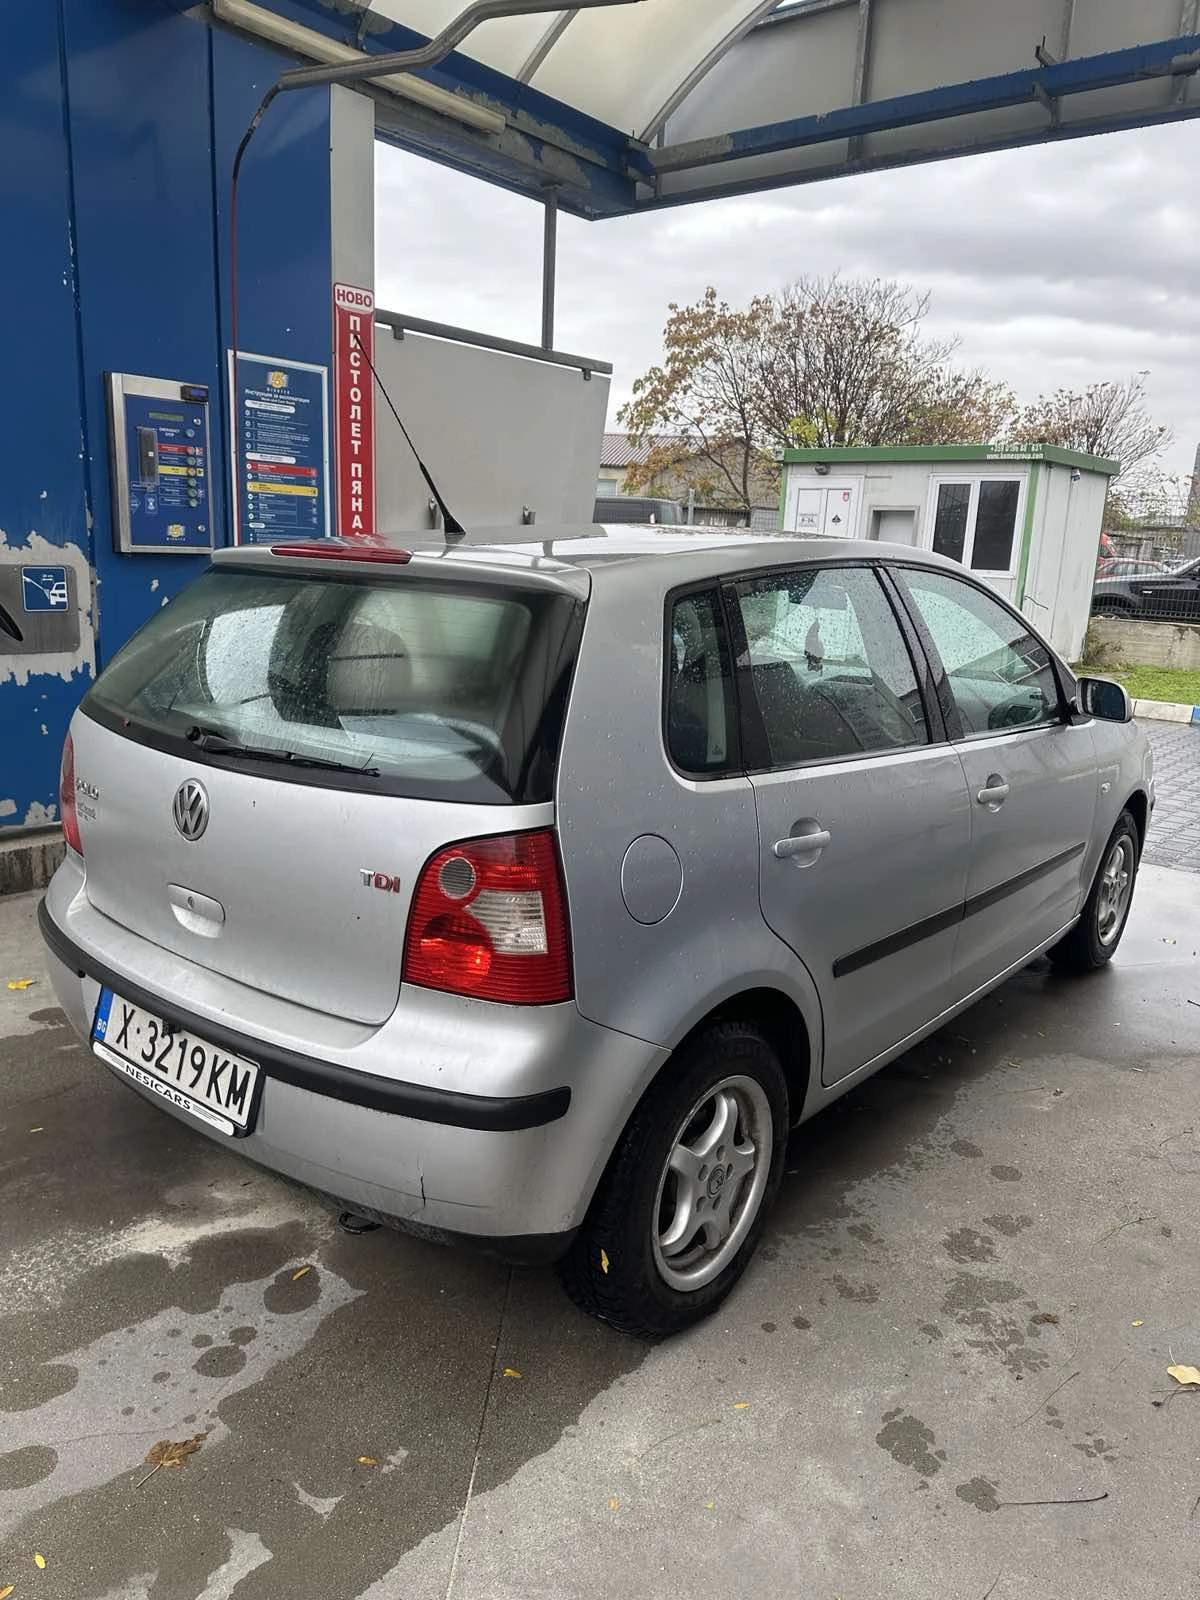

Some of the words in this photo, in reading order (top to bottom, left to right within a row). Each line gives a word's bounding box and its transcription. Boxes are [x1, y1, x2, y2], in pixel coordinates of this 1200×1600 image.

[336, 288, 373, 308] НОВО
[349, 315, 362, 454] ПИСТОЛЕТ
[351, 463, 363, 529] ПЯНА
[359, 868, 401, 893] TDI
[96, 1018, 108, 1033] BG
[125, 1064, 191, 1110] NESICARS
